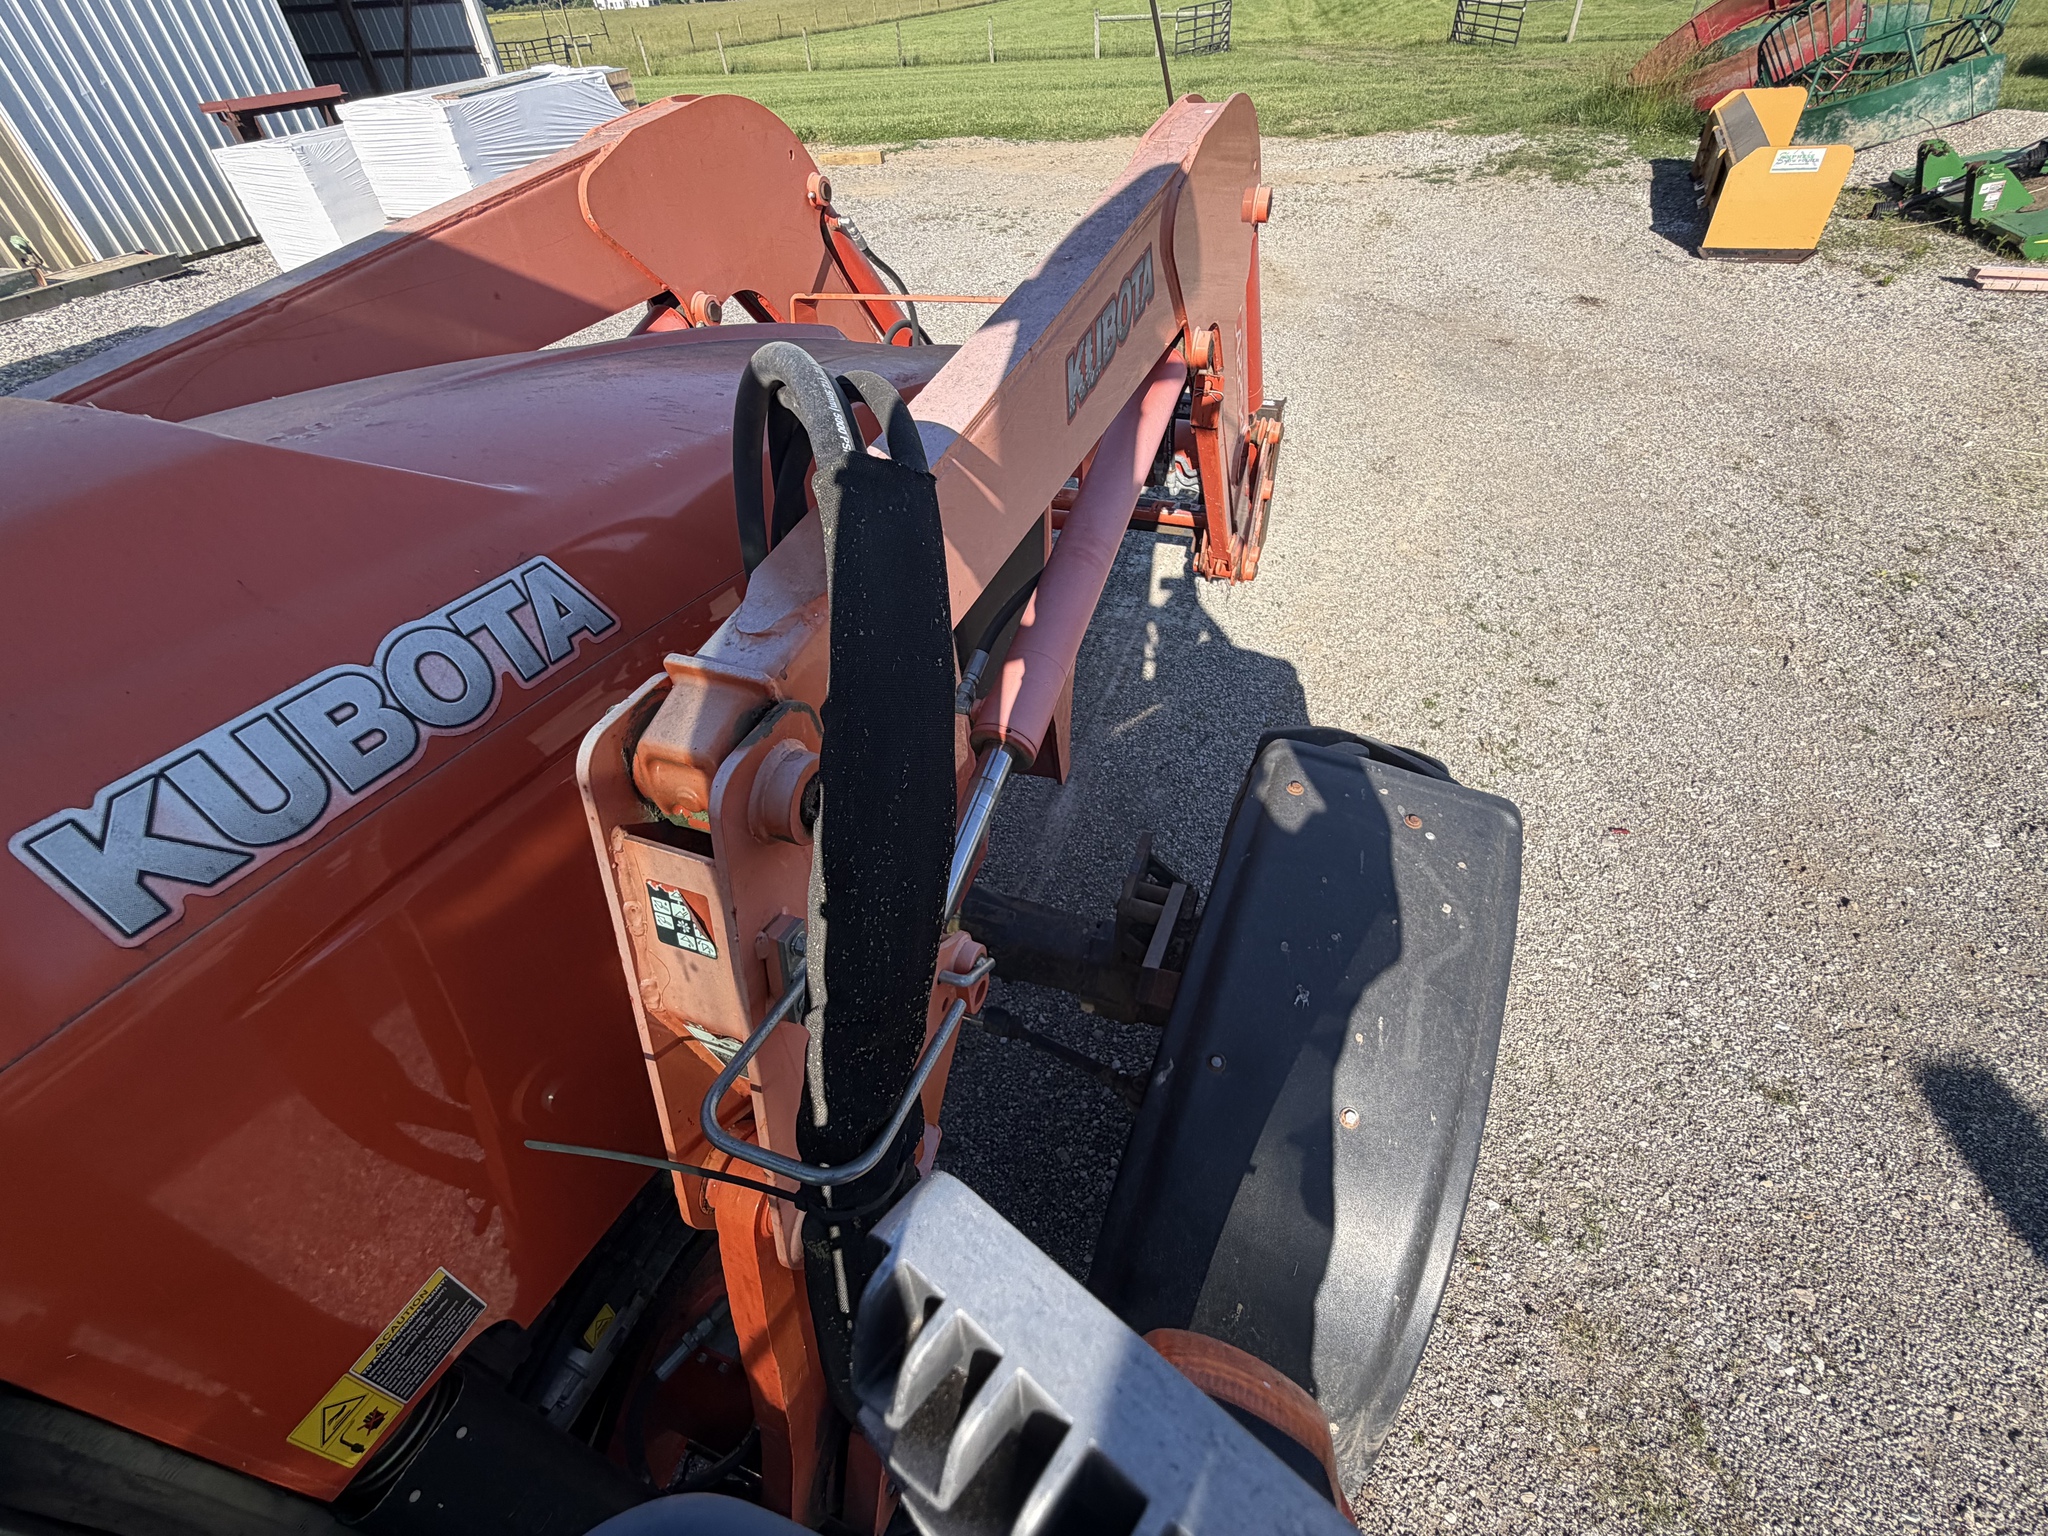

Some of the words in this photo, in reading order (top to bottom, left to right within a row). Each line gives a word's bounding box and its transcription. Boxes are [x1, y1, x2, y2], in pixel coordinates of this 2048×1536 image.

[1067, 248, 1154, 421] KUBOTA
[833, 412, 848, 435] 5000
[24, 562, 615, 938] KUBOTA
[370, 1340, 393, 1364] AVOID
[391, 1303, 425, 1341] PERSONAL
[381, 1289, 428, 1341] CAUTION
